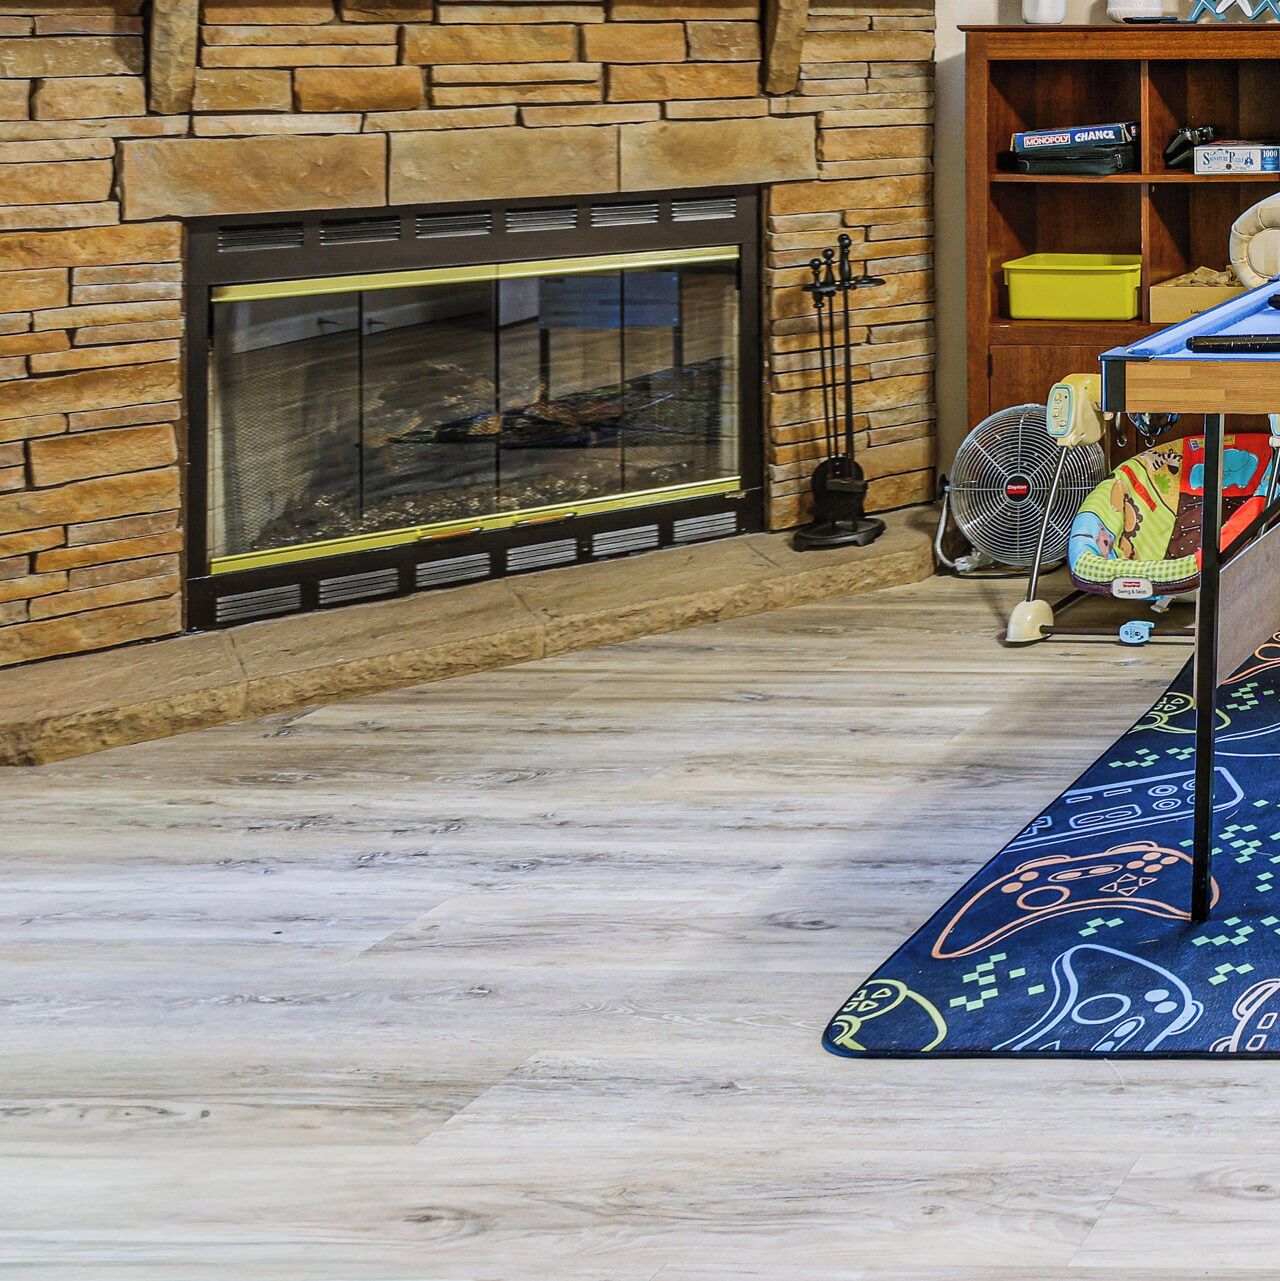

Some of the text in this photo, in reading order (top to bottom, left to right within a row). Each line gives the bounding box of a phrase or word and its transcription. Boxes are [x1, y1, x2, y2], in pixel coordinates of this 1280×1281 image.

[1026, 130, 1115, 146] MONOPOLY CHANCE
[1263, 150, 1278, 158] 1000
